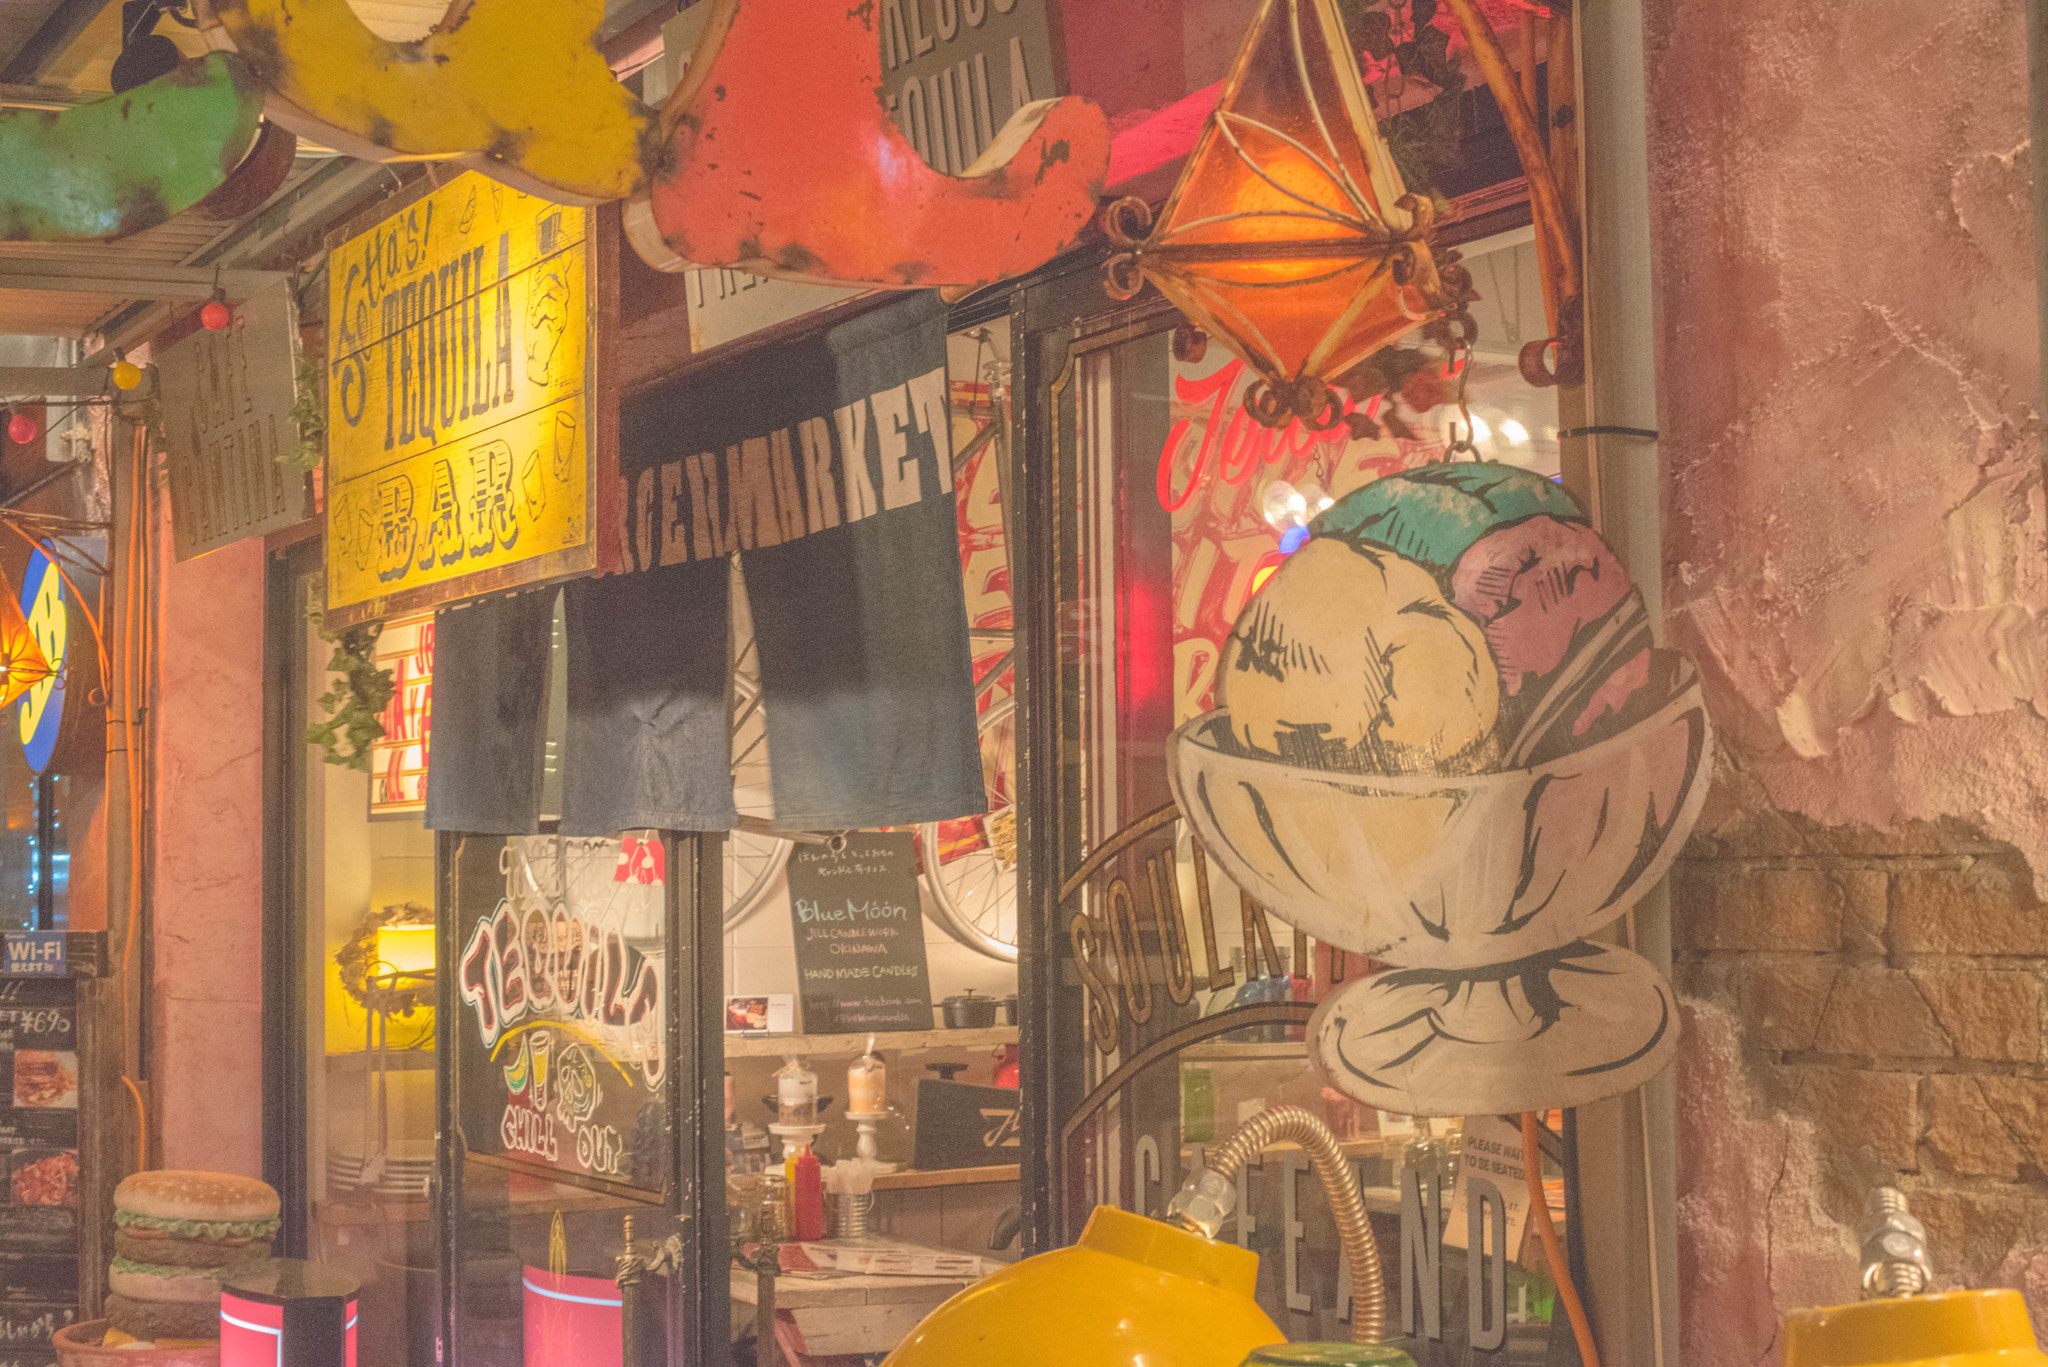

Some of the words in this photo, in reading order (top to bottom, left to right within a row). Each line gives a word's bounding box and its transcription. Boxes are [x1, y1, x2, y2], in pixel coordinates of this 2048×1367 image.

[381, 233, 514, 451] TEQUILA
[377, 439, 519, 583] BAR
[806, 927, 829, 941] JILL
[8, 940, 62, 961] Wi-Fi
[829, 943, 888, 955] OKINAWA
[872, 965, 918, 979] CANDLES
[460, 897, 667, 1091] TEQUILA
[21, 1008, 71, 1033] ¥690
[501, 1104, 558, 1162] CHILL
[576, 1124, 624, 1174] OUT
[1467, 1136, 1503, 1156] PLEASE
[1464, 1153, 1477, 1167] TO
[1478, 1157, 1490, 1172] BE
[1491, 1161, 1526, 1181] SEATED
